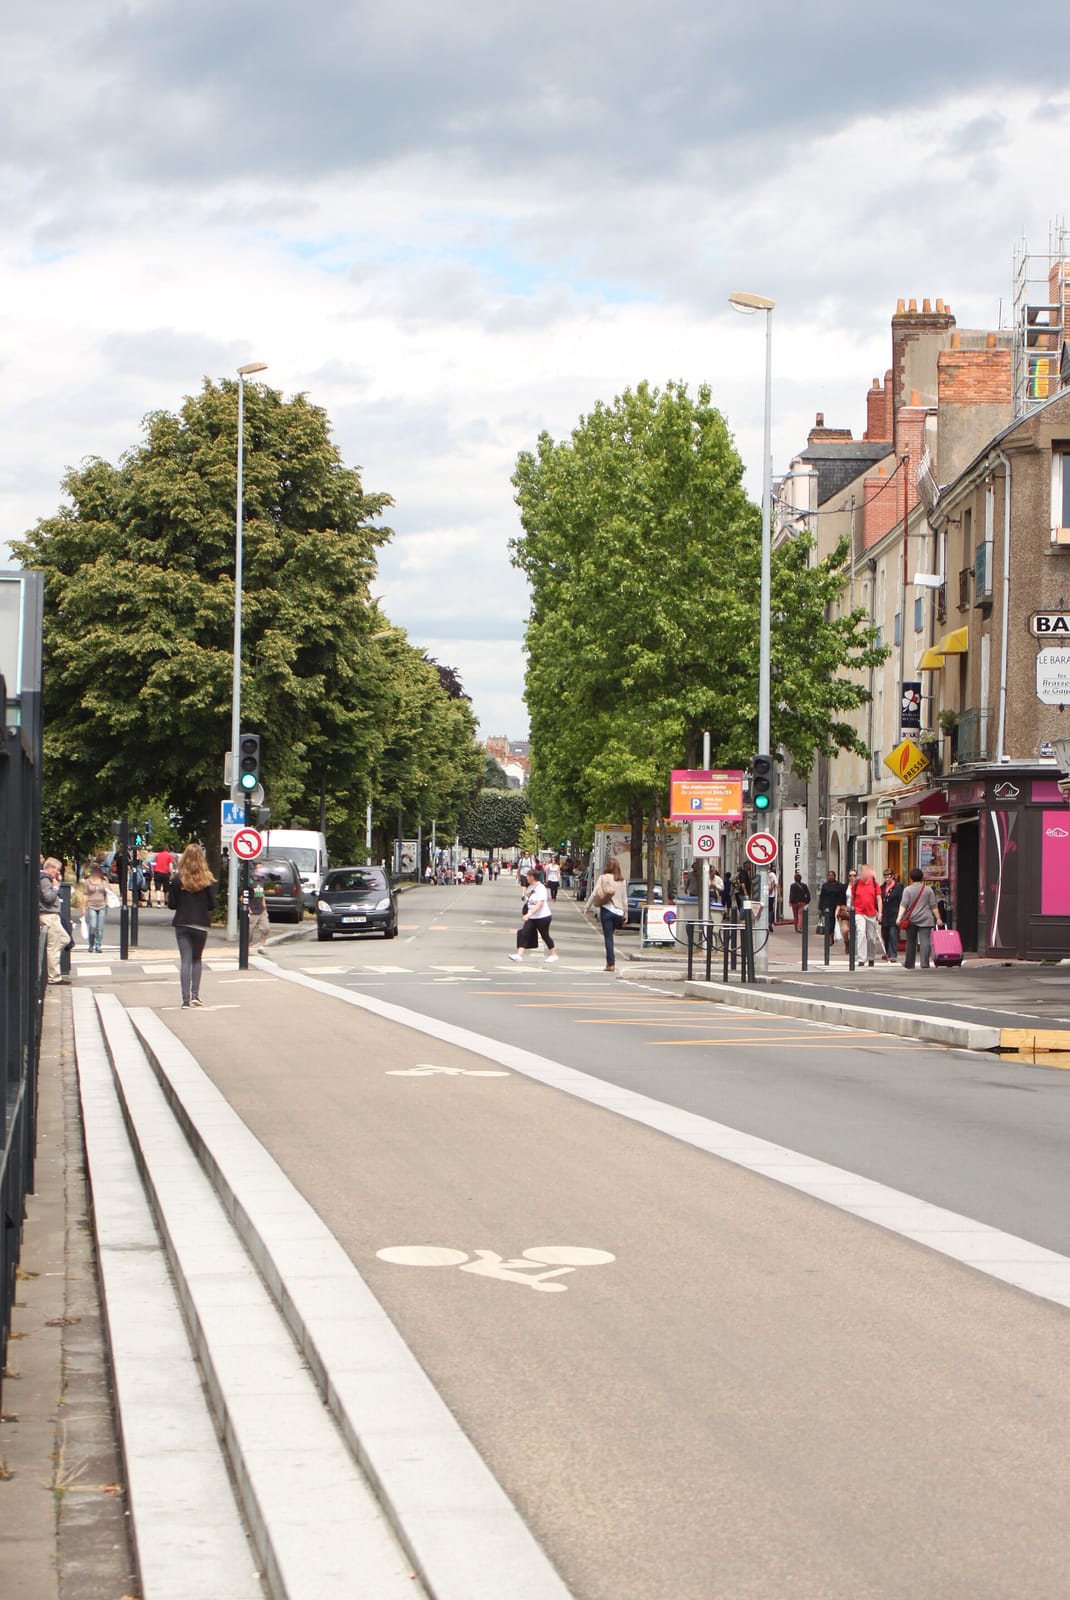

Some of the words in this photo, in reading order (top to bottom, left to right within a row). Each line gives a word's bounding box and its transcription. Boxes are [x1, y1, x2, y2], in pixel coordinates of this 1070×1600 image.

[1039, 656, 1048, 665] LE
[903, 757, 927, 781] PRESSE
[692, 799, 700, 809] P
[701, 839, 711, 847] 30
